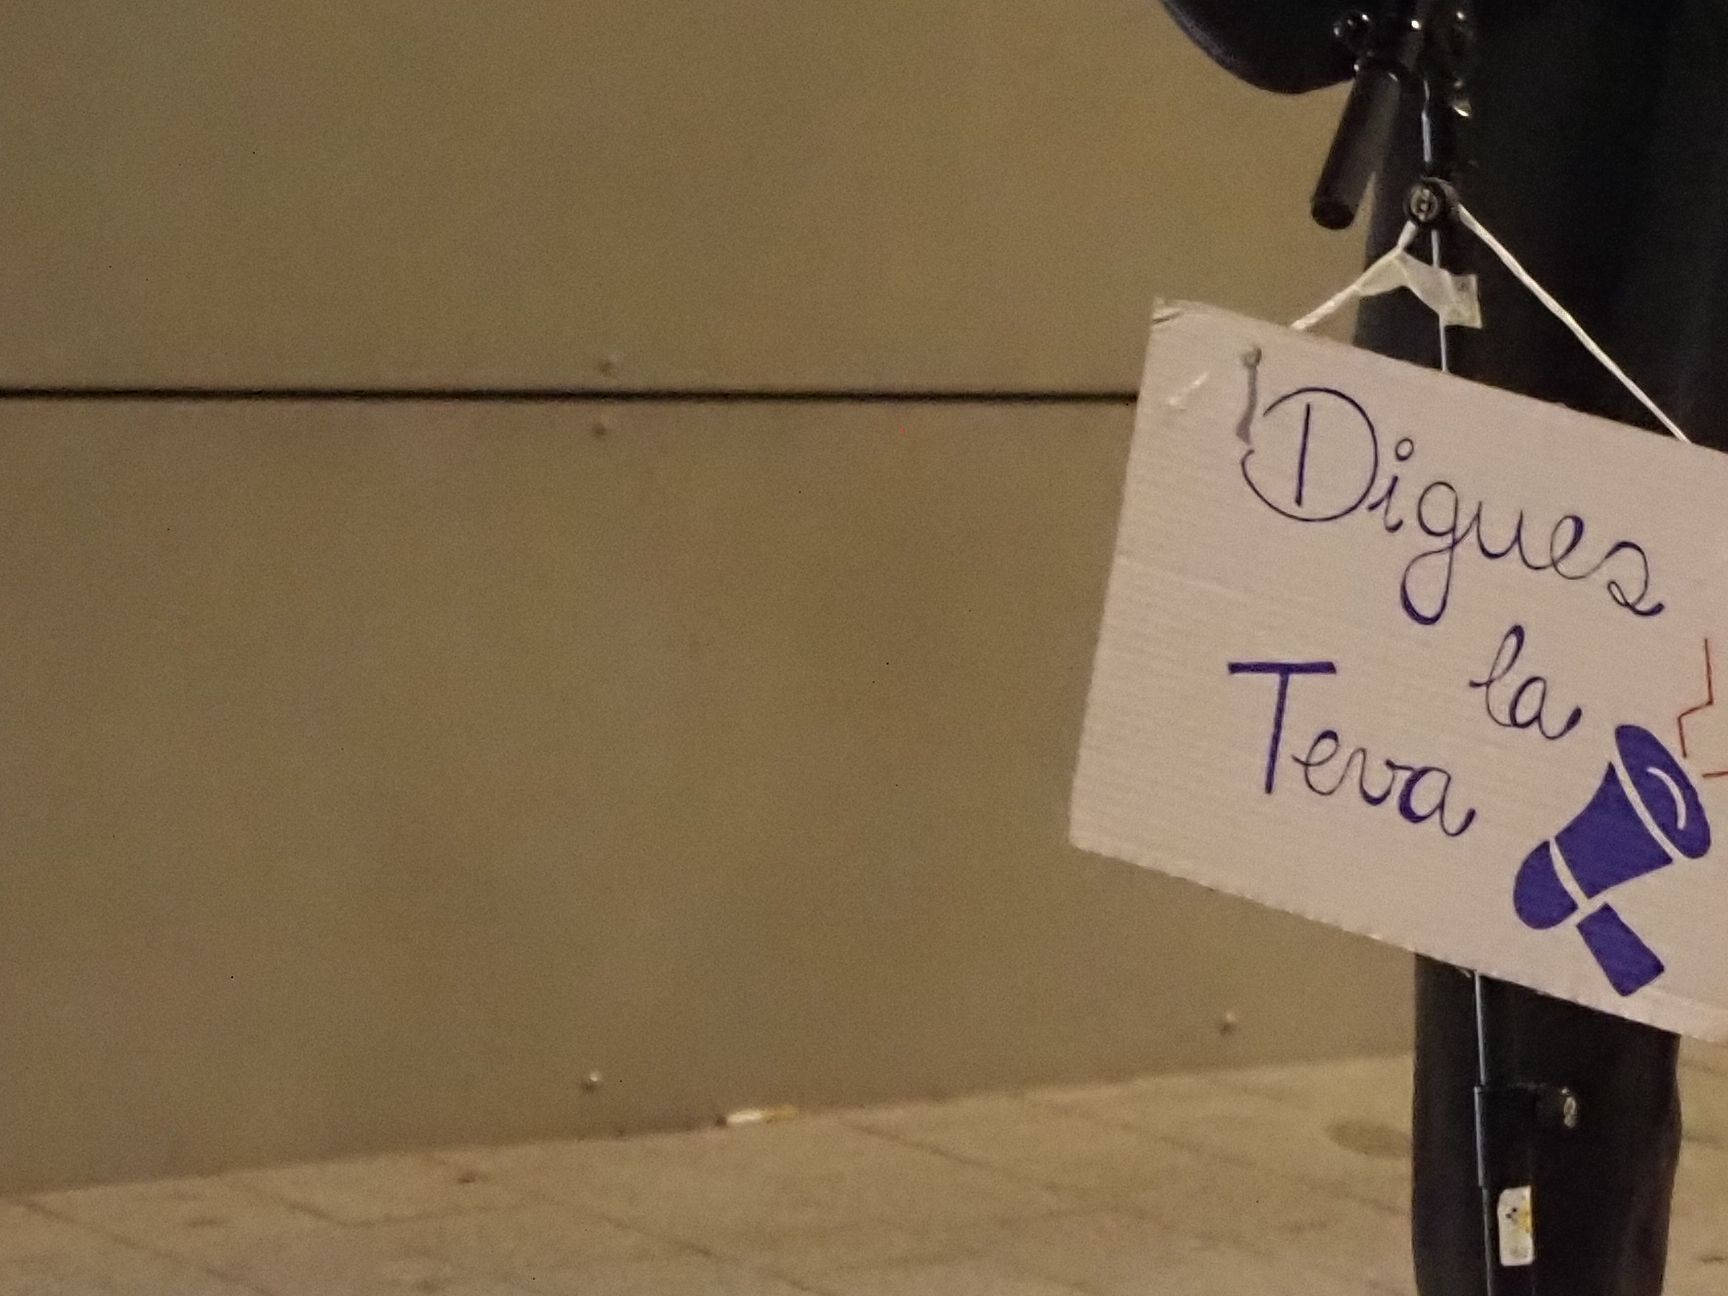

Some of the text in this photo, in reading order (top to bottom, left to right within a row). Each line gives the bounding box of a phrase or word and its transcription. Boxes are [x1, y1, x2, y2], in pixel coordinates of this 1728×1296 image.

[1242, 387, 1664, 625] Digues
[1228, 661, 1476, 837] Teva
[1468, 626, 1582, 740] la
